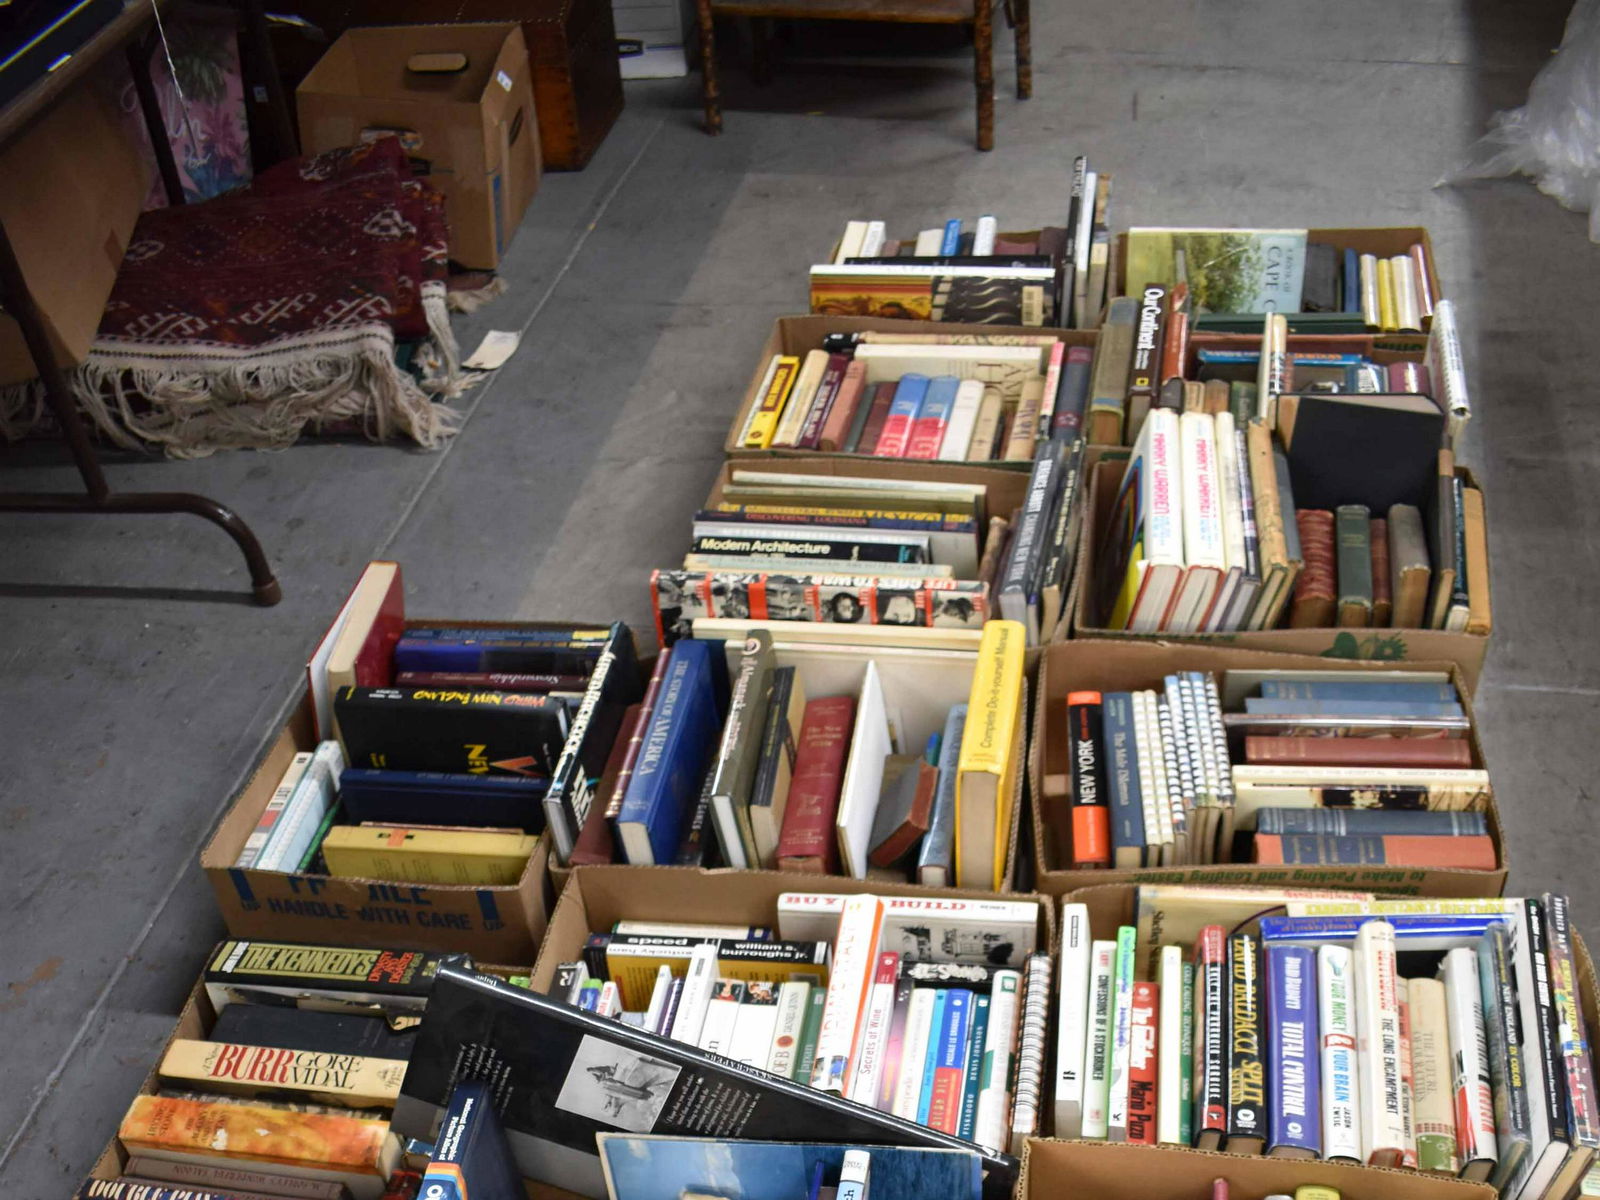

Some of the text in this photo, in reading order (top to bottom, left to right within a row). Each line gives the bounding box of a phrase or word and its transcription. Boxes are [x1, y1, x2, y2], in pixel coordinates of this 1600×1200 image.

[1144, 288, 1165, 306] Our
[701, 538, 831, 555] Modern Architecture
[639, 717, 671, 776] AMERICA
[1077, 739, 1096, 804] NEW YORK
[1190, 870, 1252, 882] Loading
[1258, 871, 1288, 882] and
[1292, 870, 1357, 883] Packing
[1361, 871, 1406, 883] Make
[267, 898, 474, 931] HANDLE WITH CARE
[889, 899, 967, 911] BUILD
[627, 937, 689, 948] speed
[721, 948, 792, 959] burroughs
[734, 941, 781, 951] william
[1502, 985, 1513, 1002] NEW
[1233, 983, 1259, 1056] BALDACCI
[1503, 1004, 1518, 1045] ENGLAND
[209, 1044, 294, 1085] BURR
[294, 1051, 366, 1073] GORE
[860, 1041, 875, 1075] Secrets
[1331, 1001, 1350, 1102] MONEY YOUR BRAIN
[291, 1066, 355, 1090] VIDAL
[1281, 1021, 1306, 1117] TOTAL CONTROL
[1382, 1018, 1399, 1115] THE LONG ENCAMPMENT
[1510, 1056, 1522, 1088] COLOR
[1242, 1060, 1264, 1106] SPLIT
[1129, 1080, 1154, 1140] Mario Puzo
